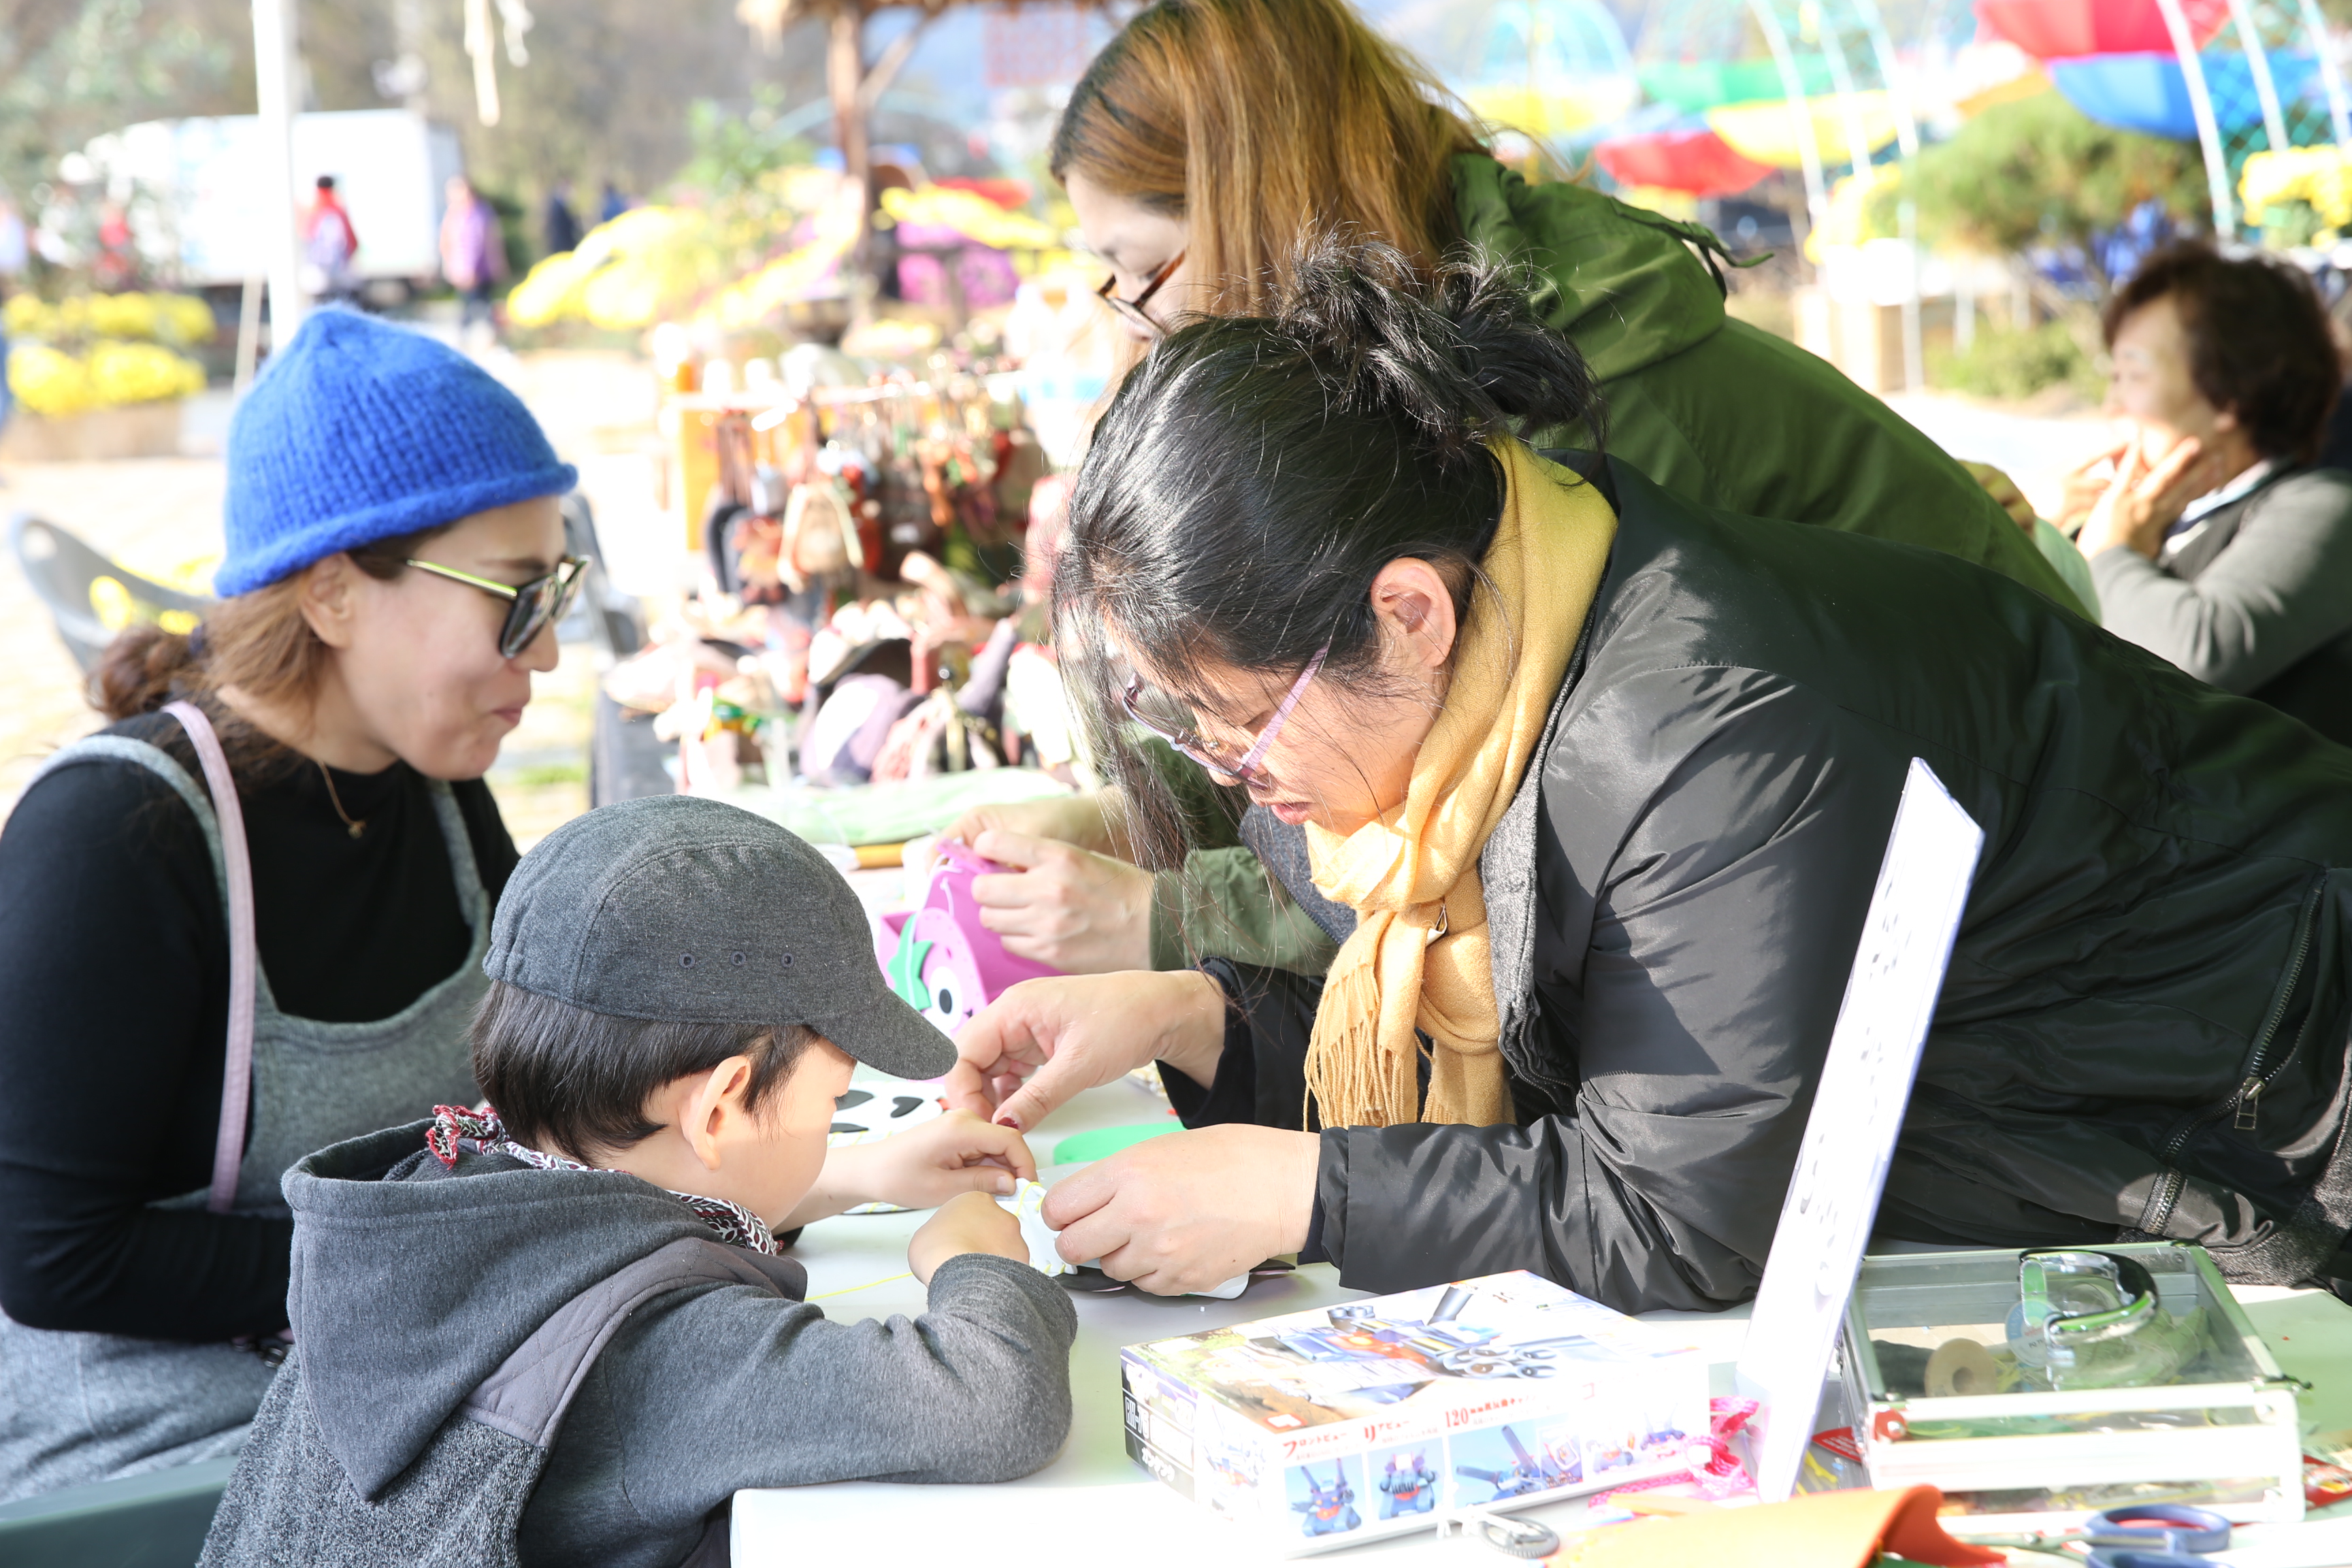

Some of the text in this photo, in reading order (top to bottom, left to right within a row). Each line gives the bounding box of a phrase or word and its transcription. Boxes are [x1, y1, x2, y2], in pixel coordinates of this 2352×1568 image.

[1364, 1420, 1409, 1443] リアビュー
